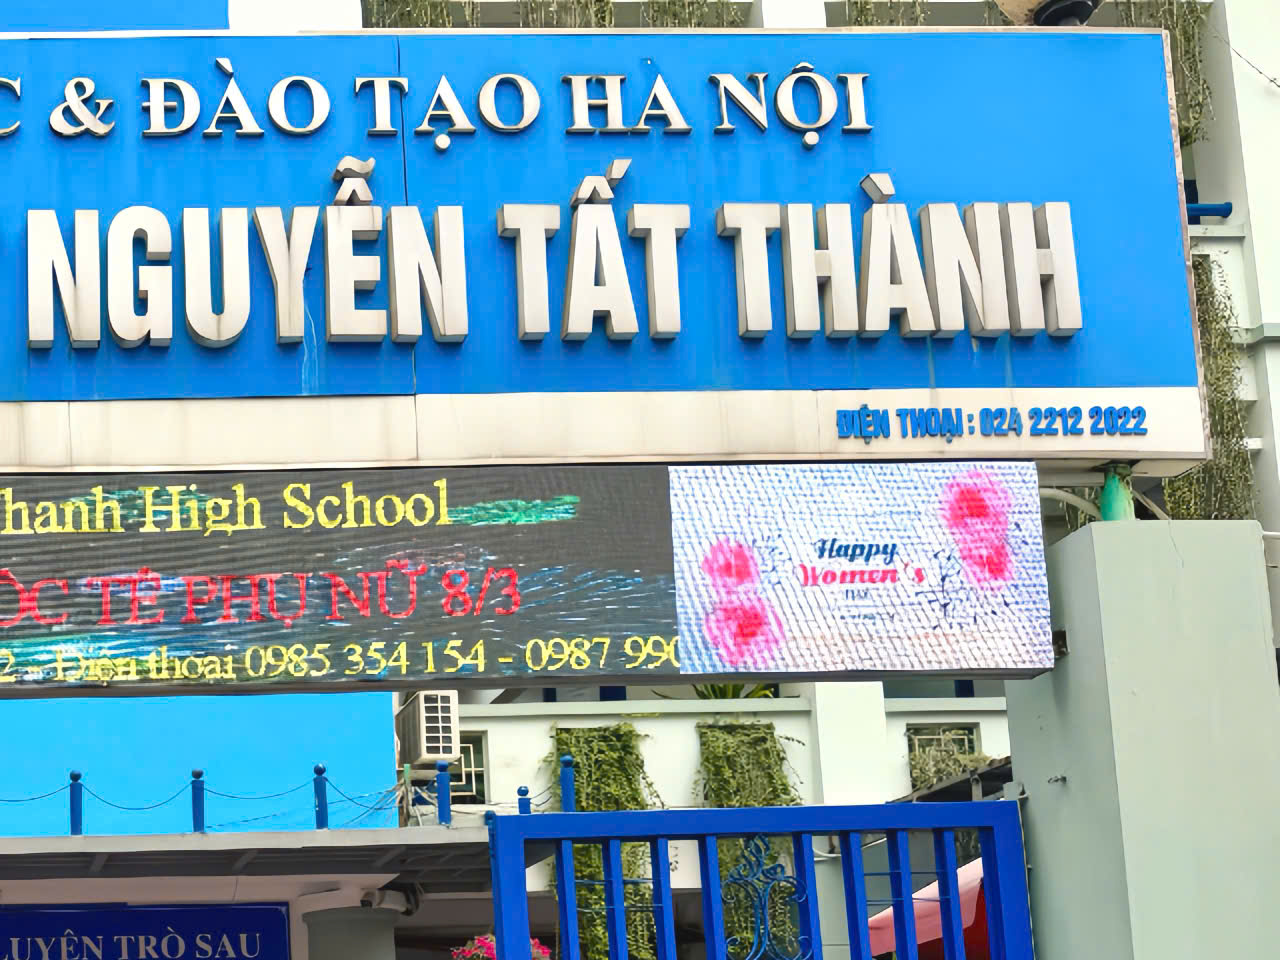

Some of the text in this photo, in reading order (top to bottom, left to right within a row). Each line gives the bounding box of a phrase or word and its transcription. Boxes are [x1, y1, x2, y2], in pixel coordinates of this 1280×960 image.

[49, 76, 116, 137] &
[142, 58, 330, 137] ĐÀO
[355, 74, 540, 150] TẠO
[709, 61, 873, 149] NỘI
[26, 156, 467, 350] NGUYỄN
[497, 159, 691, 343] TẤT
[717, 173, 1084, 340] THÀNH
[836, 403, 890, 445] ĐIỆN
[979, 407, 1024, 437] 024
[1028, 406, 1084, 436] 2212
[1089, 406, 1148, 436] 2022
[138, 483, 266, 536] High
[283, 478, 454, 530] School
[816, 538, 898, 565] Happy
[441, 567, 521, 617] 8/3
[245, 643, 330, 678] 0985
[344, 642, 410, 676] 354
[422, 639, 485, 674] 154
[525, 637, 611, 671] 0987
[113, 927, 186, 960] TRÒ
[195, 931, 261, 959] SAU
